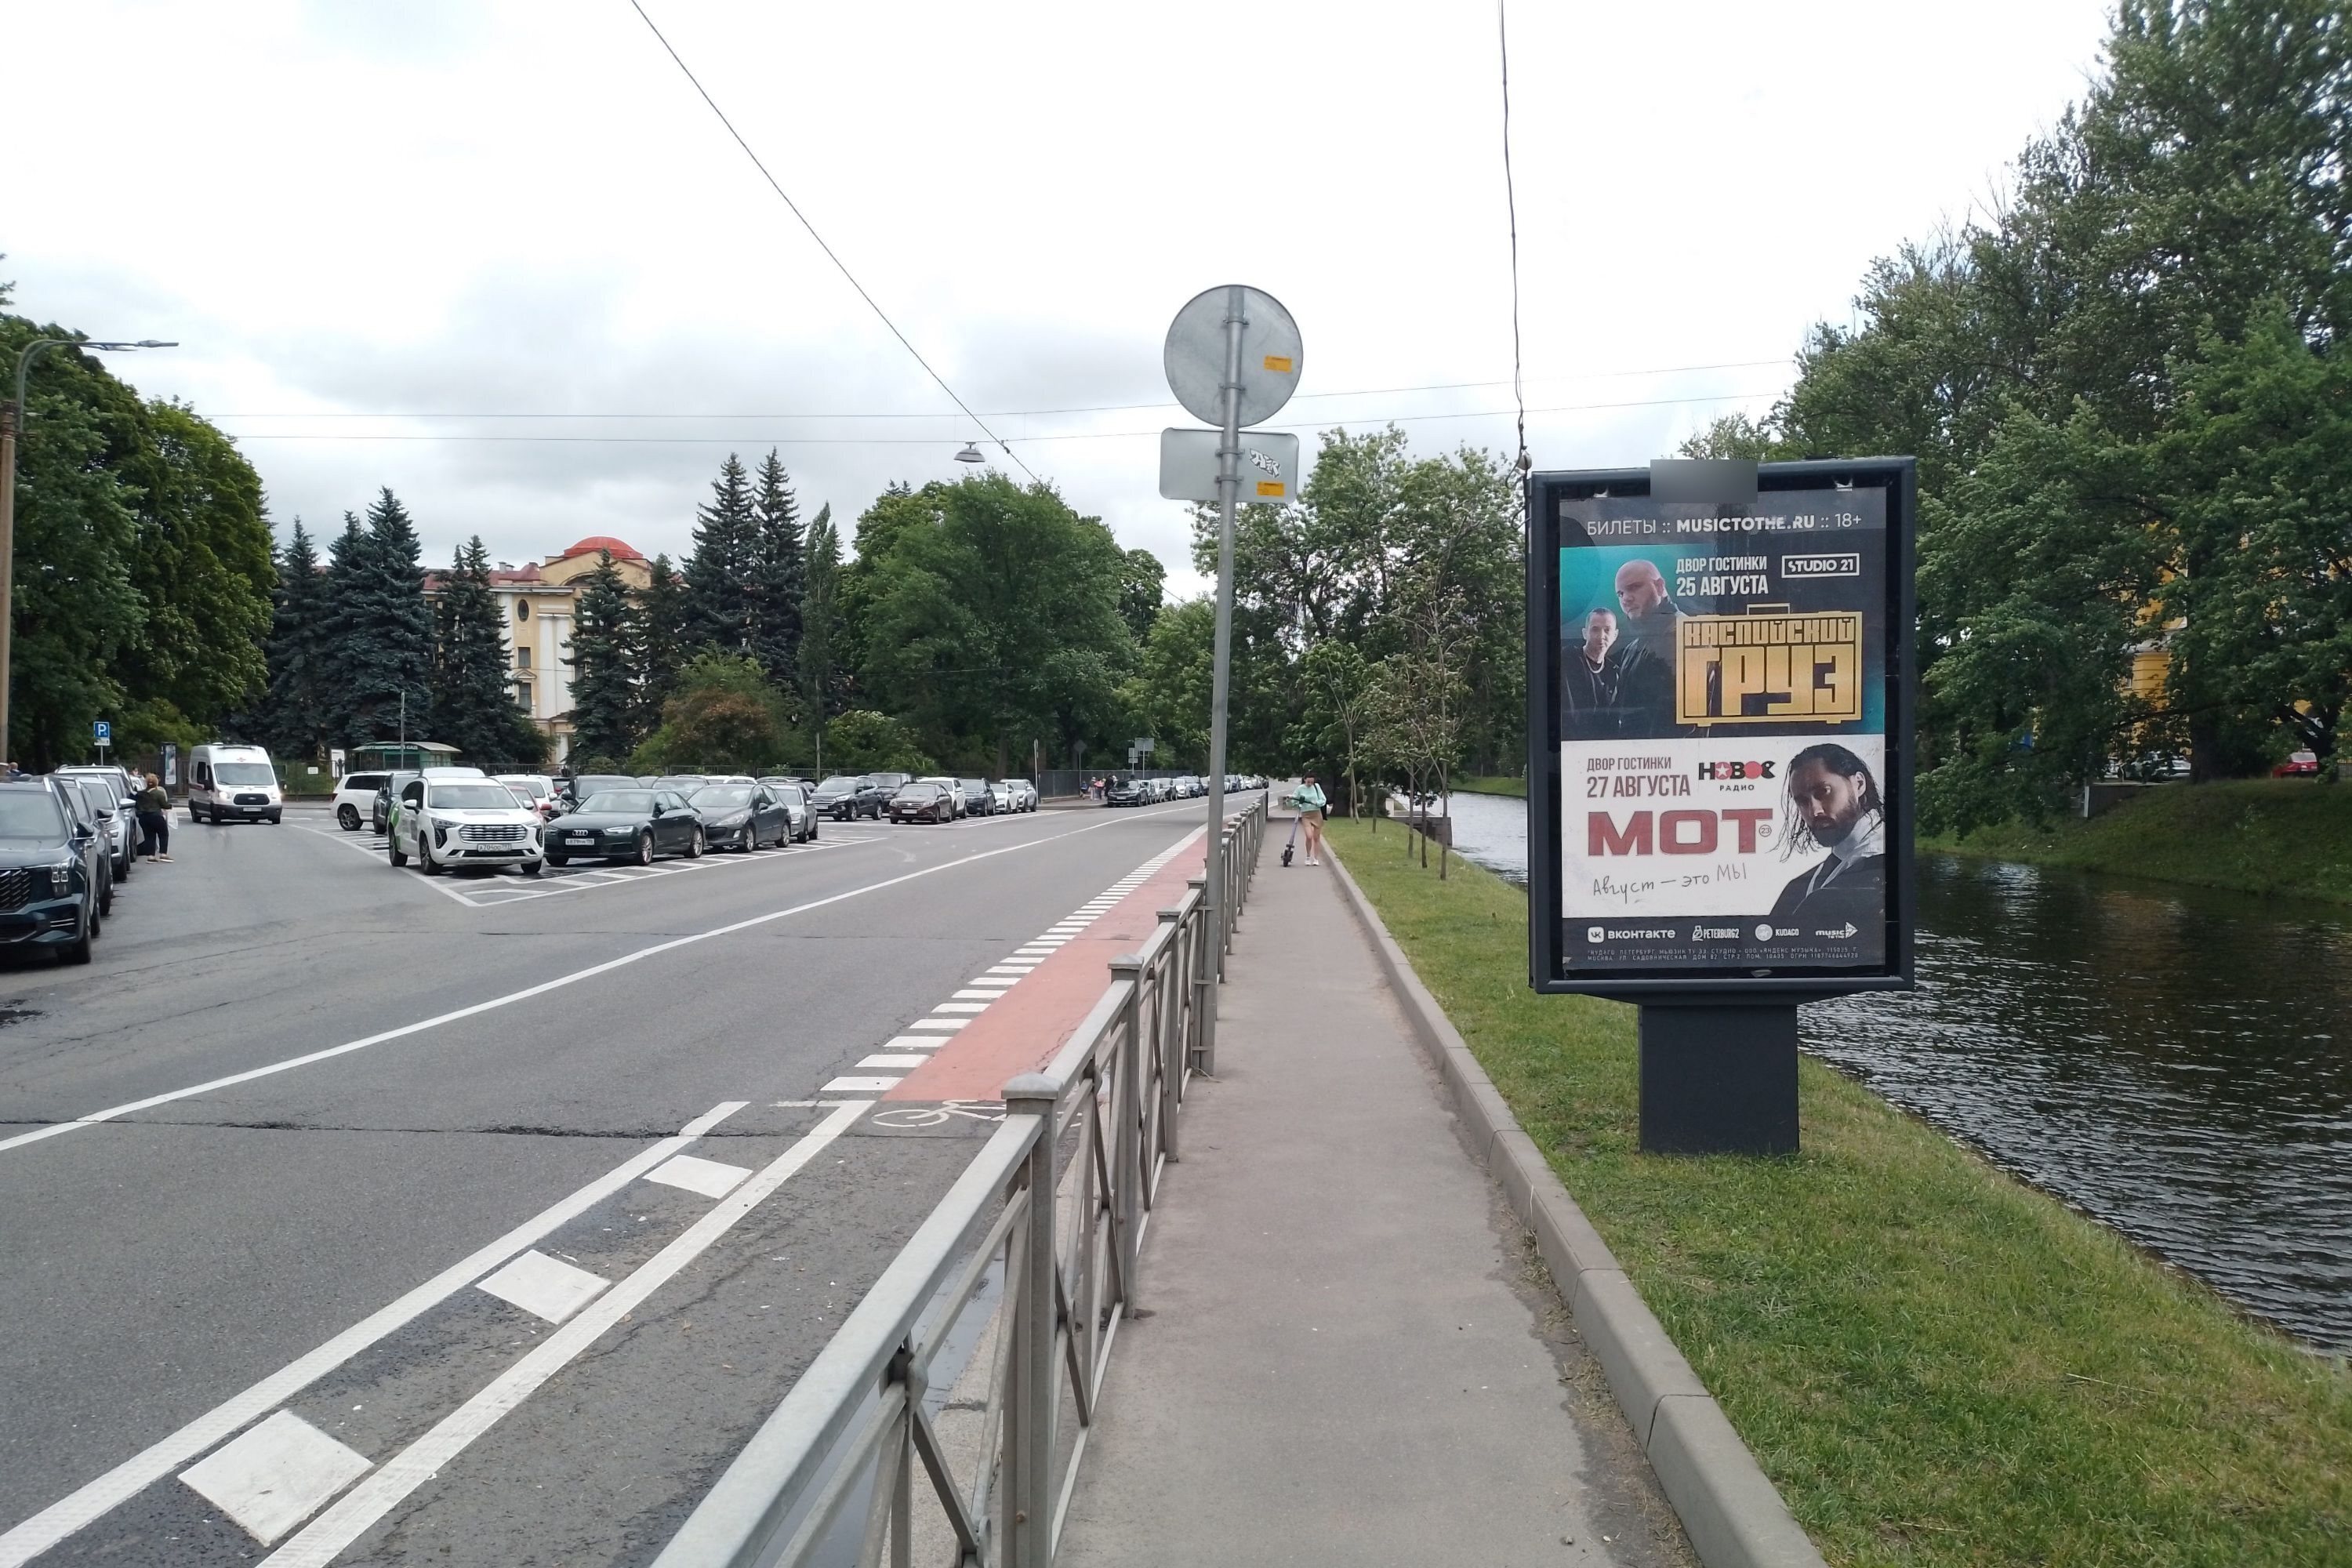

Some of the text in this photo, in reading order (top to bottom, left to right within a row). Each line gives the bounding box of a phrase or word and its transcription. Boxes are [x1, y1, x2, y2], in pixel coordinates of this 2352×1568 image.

[1587, 519, 1656, 535] БИЛЕТЫ
[1676, 514, 1815, 534] MUSICTOTHE.RU
[1835, 513, 1862, 528] 18+
[1675, 556, 1768, 574] ДВОР ГОСТИНКИ
[1788, 558, 1854, 573] STUDIO 21
[1676, 575, 1769, 597] 25 АВГУСТА
[1684, 617, 1855, 647] КАСПИЙСКИЙ
[1683, 644, 1854, 717] ГРУЗ
[1587, 757, 1671, 772] ДВОР ГОСТИНКИ
[1587, 775, 1691, 798] 27 АВГУСТА
[1588, 808, 1773, 856] МОТ
[1593, 876, 1654, 904] Август
[1682, 875, 1709, 887] это
[1717, 862, 1747, 881] МЫ
[1607, 929, 1676, 939] вконтакте
